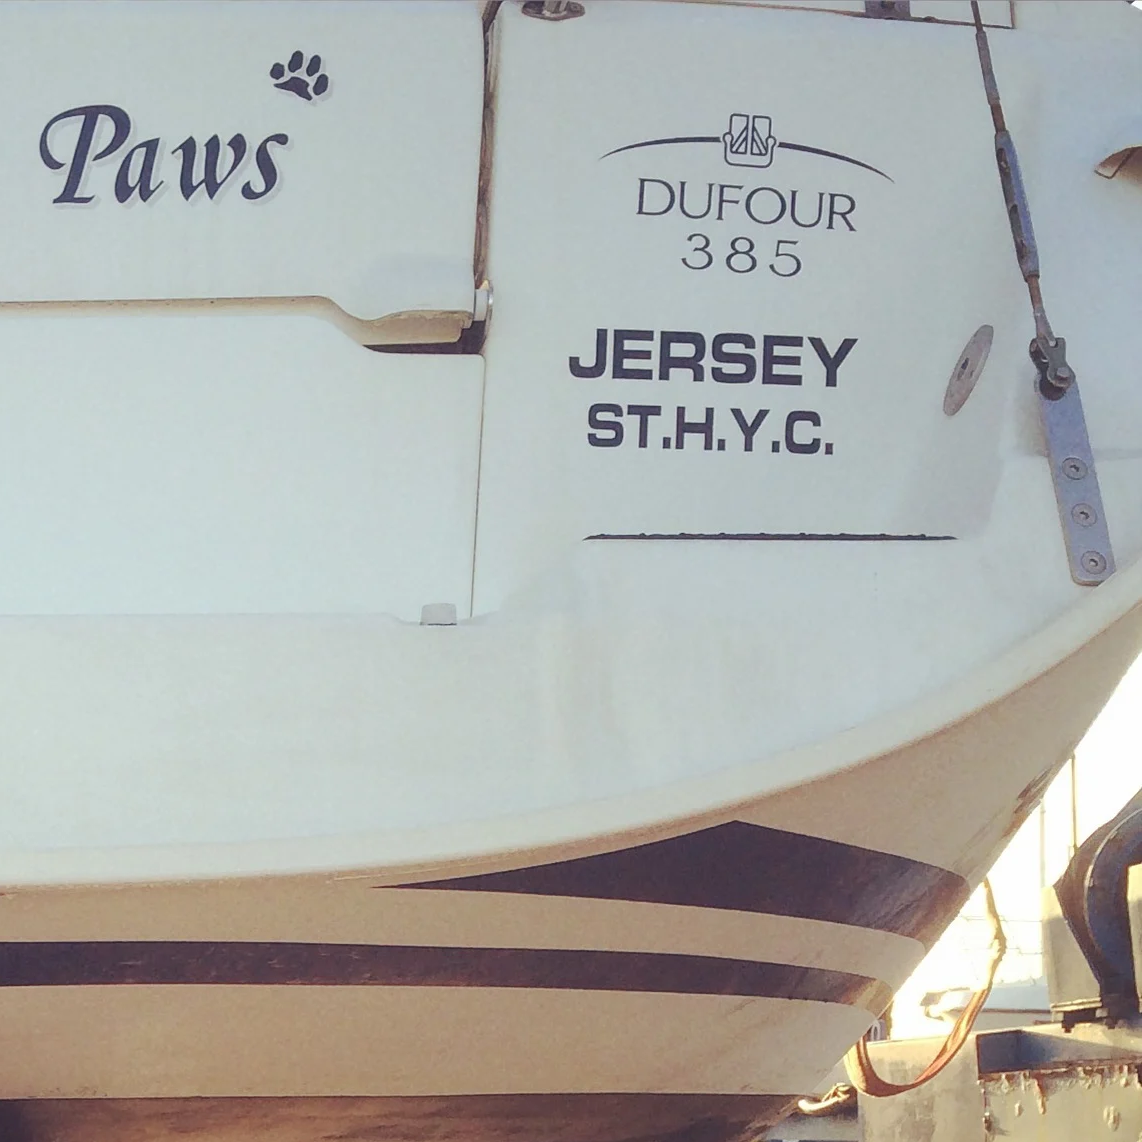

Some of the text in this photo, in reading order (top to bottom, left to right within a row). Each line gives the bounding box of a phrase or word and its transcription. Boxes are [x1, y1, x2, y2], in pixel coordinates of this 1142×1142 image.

[39, 103, 290, 205] Paws
[636, 177, 857, 232] DUFOUR
[681, 233, 802, 278] 385
[568, 328, 859, 388] JERSEY
[587, 403, 834, 455] ST.H.Y.C.
